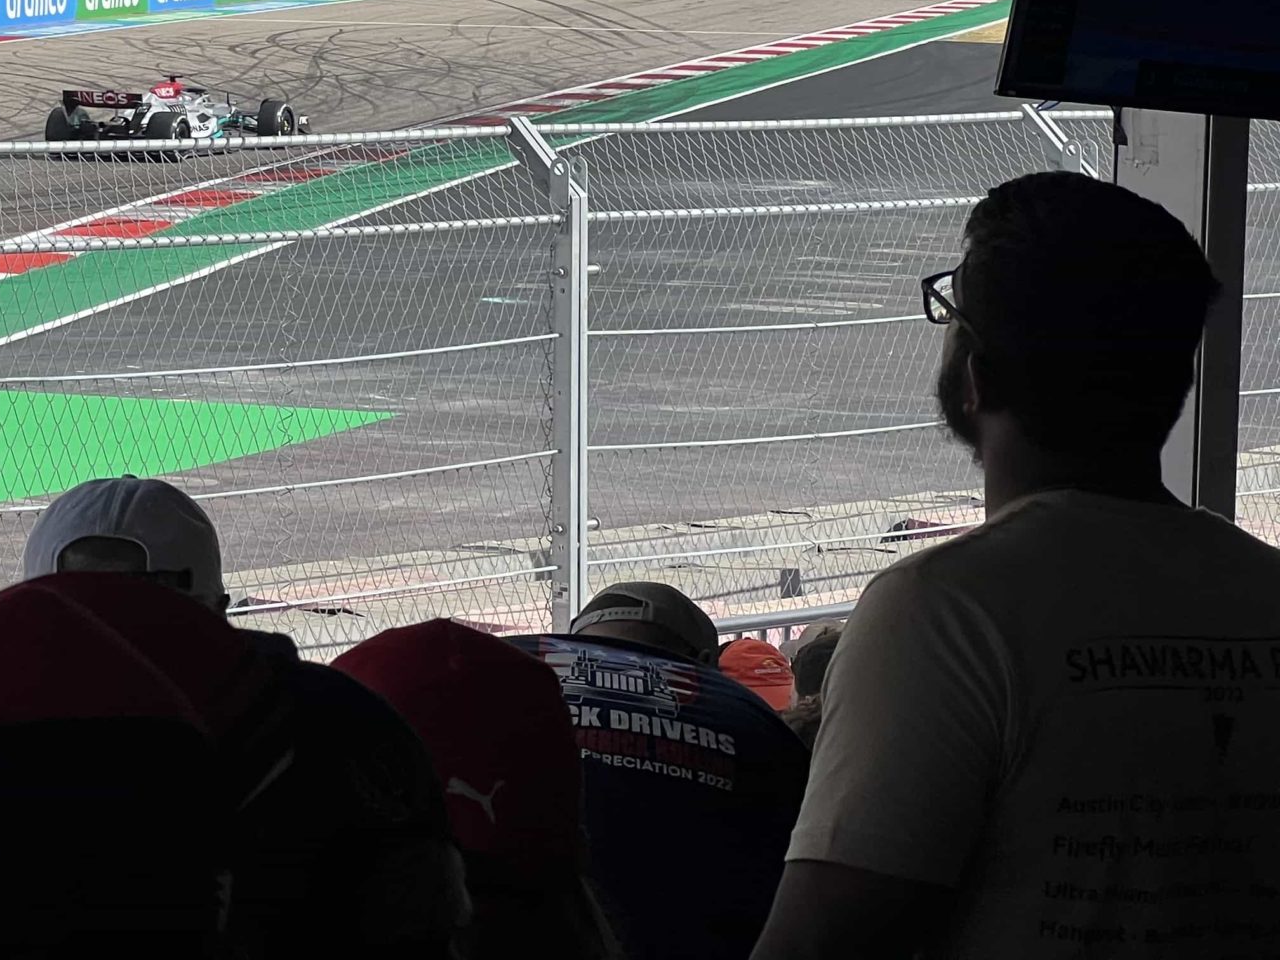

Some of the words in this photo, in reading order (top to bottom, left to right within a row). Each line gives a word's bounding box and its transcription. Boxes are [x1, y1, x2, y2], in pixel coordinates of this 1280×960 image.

[78, 93, 128, 105] INEOS
[155, 87, 174, 97] INEOS
[190, 124, 210, 133] NAS
[1065, 644, 1262, 683] SHAWARMA
[609, 710, 736, 756] DRIVERS
[697, 771, 734, 792] 2022
